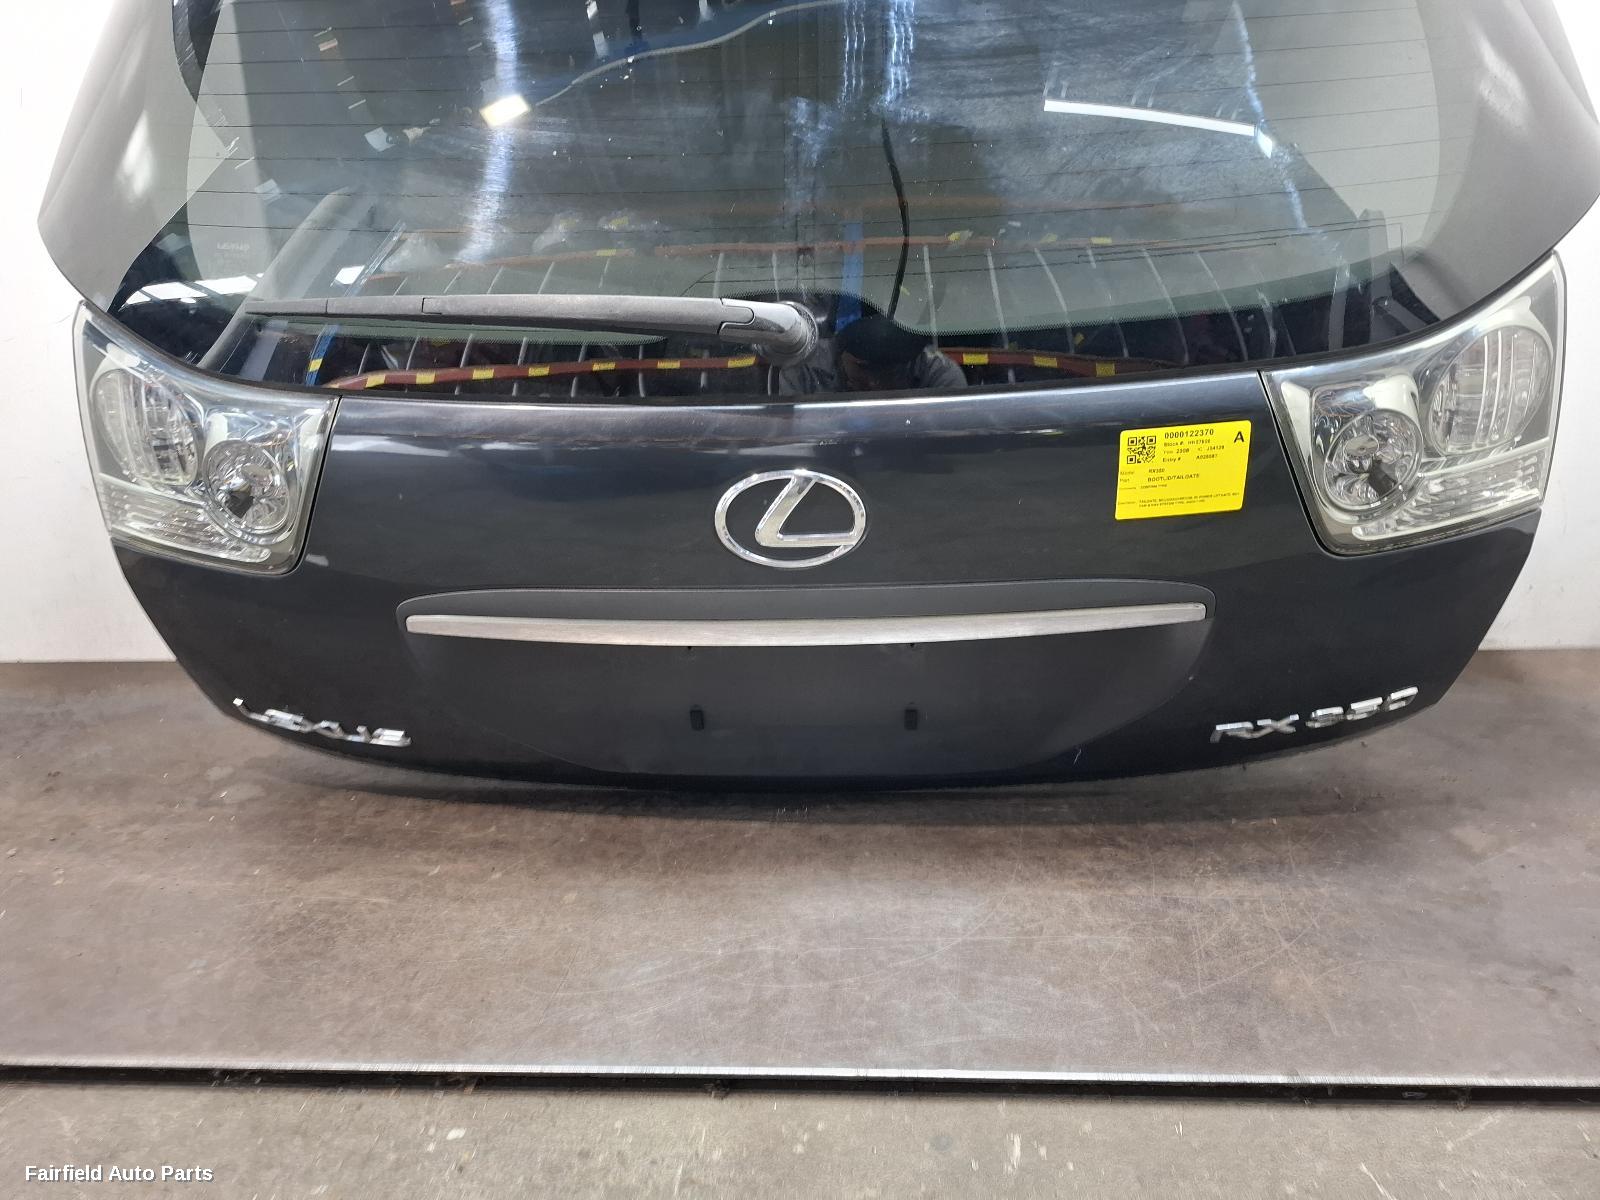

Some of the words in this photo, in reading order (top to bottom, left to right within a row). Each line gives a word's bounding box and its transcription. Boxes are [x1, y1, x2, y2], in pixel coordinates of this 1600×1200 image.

[1164, 428, 1214, 439] 0000122370
[1233, 431, 1244, 443] A
[1210, 713, 1299, 743] RX
